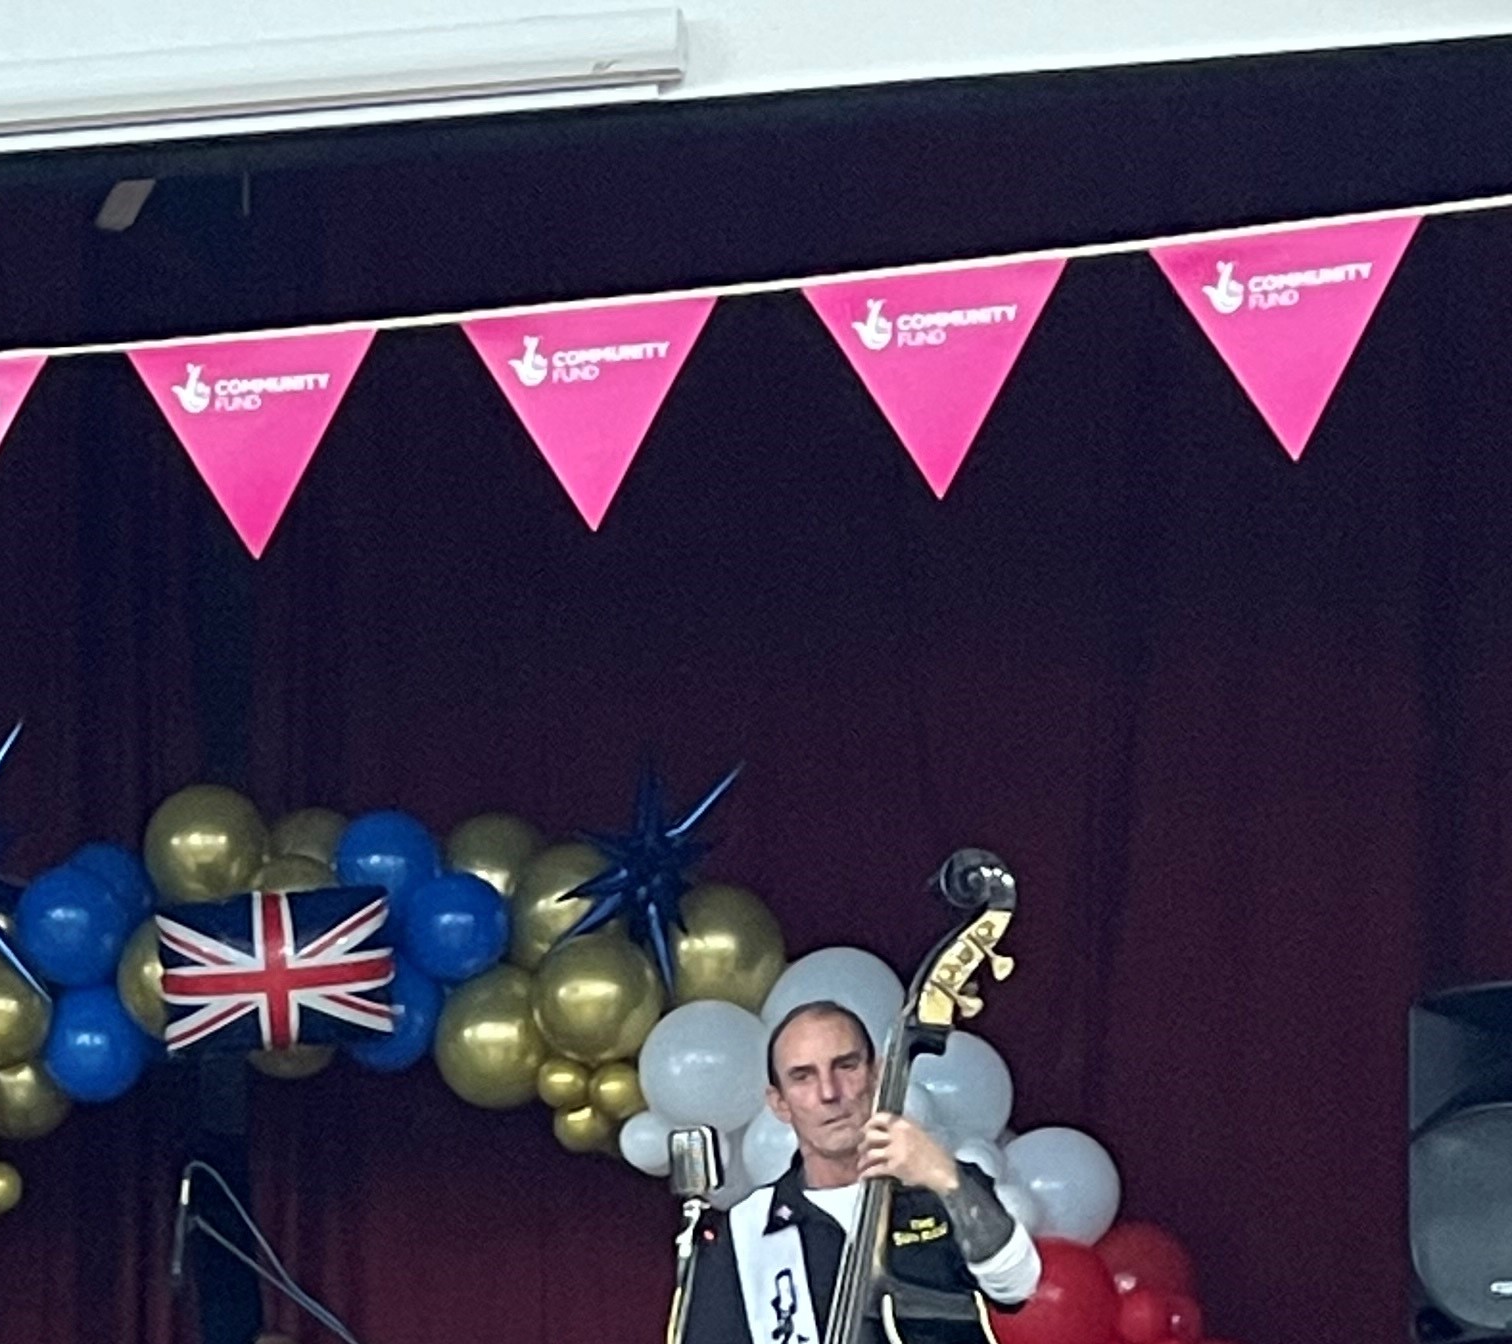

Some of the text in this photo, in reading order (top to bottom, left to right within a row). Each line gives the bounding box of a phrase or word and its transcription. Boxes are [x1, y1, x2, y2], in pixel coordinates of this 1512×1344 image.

[1249, 262, 1372, 293] COMMUNITY
[1248, 288, 1299, 310] FUND
[897, 304, 1018, 331] COMMUNITY
[898, 328, 946, 347] FUND
[552, 341, 670, 368] COMMUNITY
[214, 373, 330, 396] COMMUNITY
[552, 364, 600, 384] FUND
[215, 394, 262, 411] FUND
